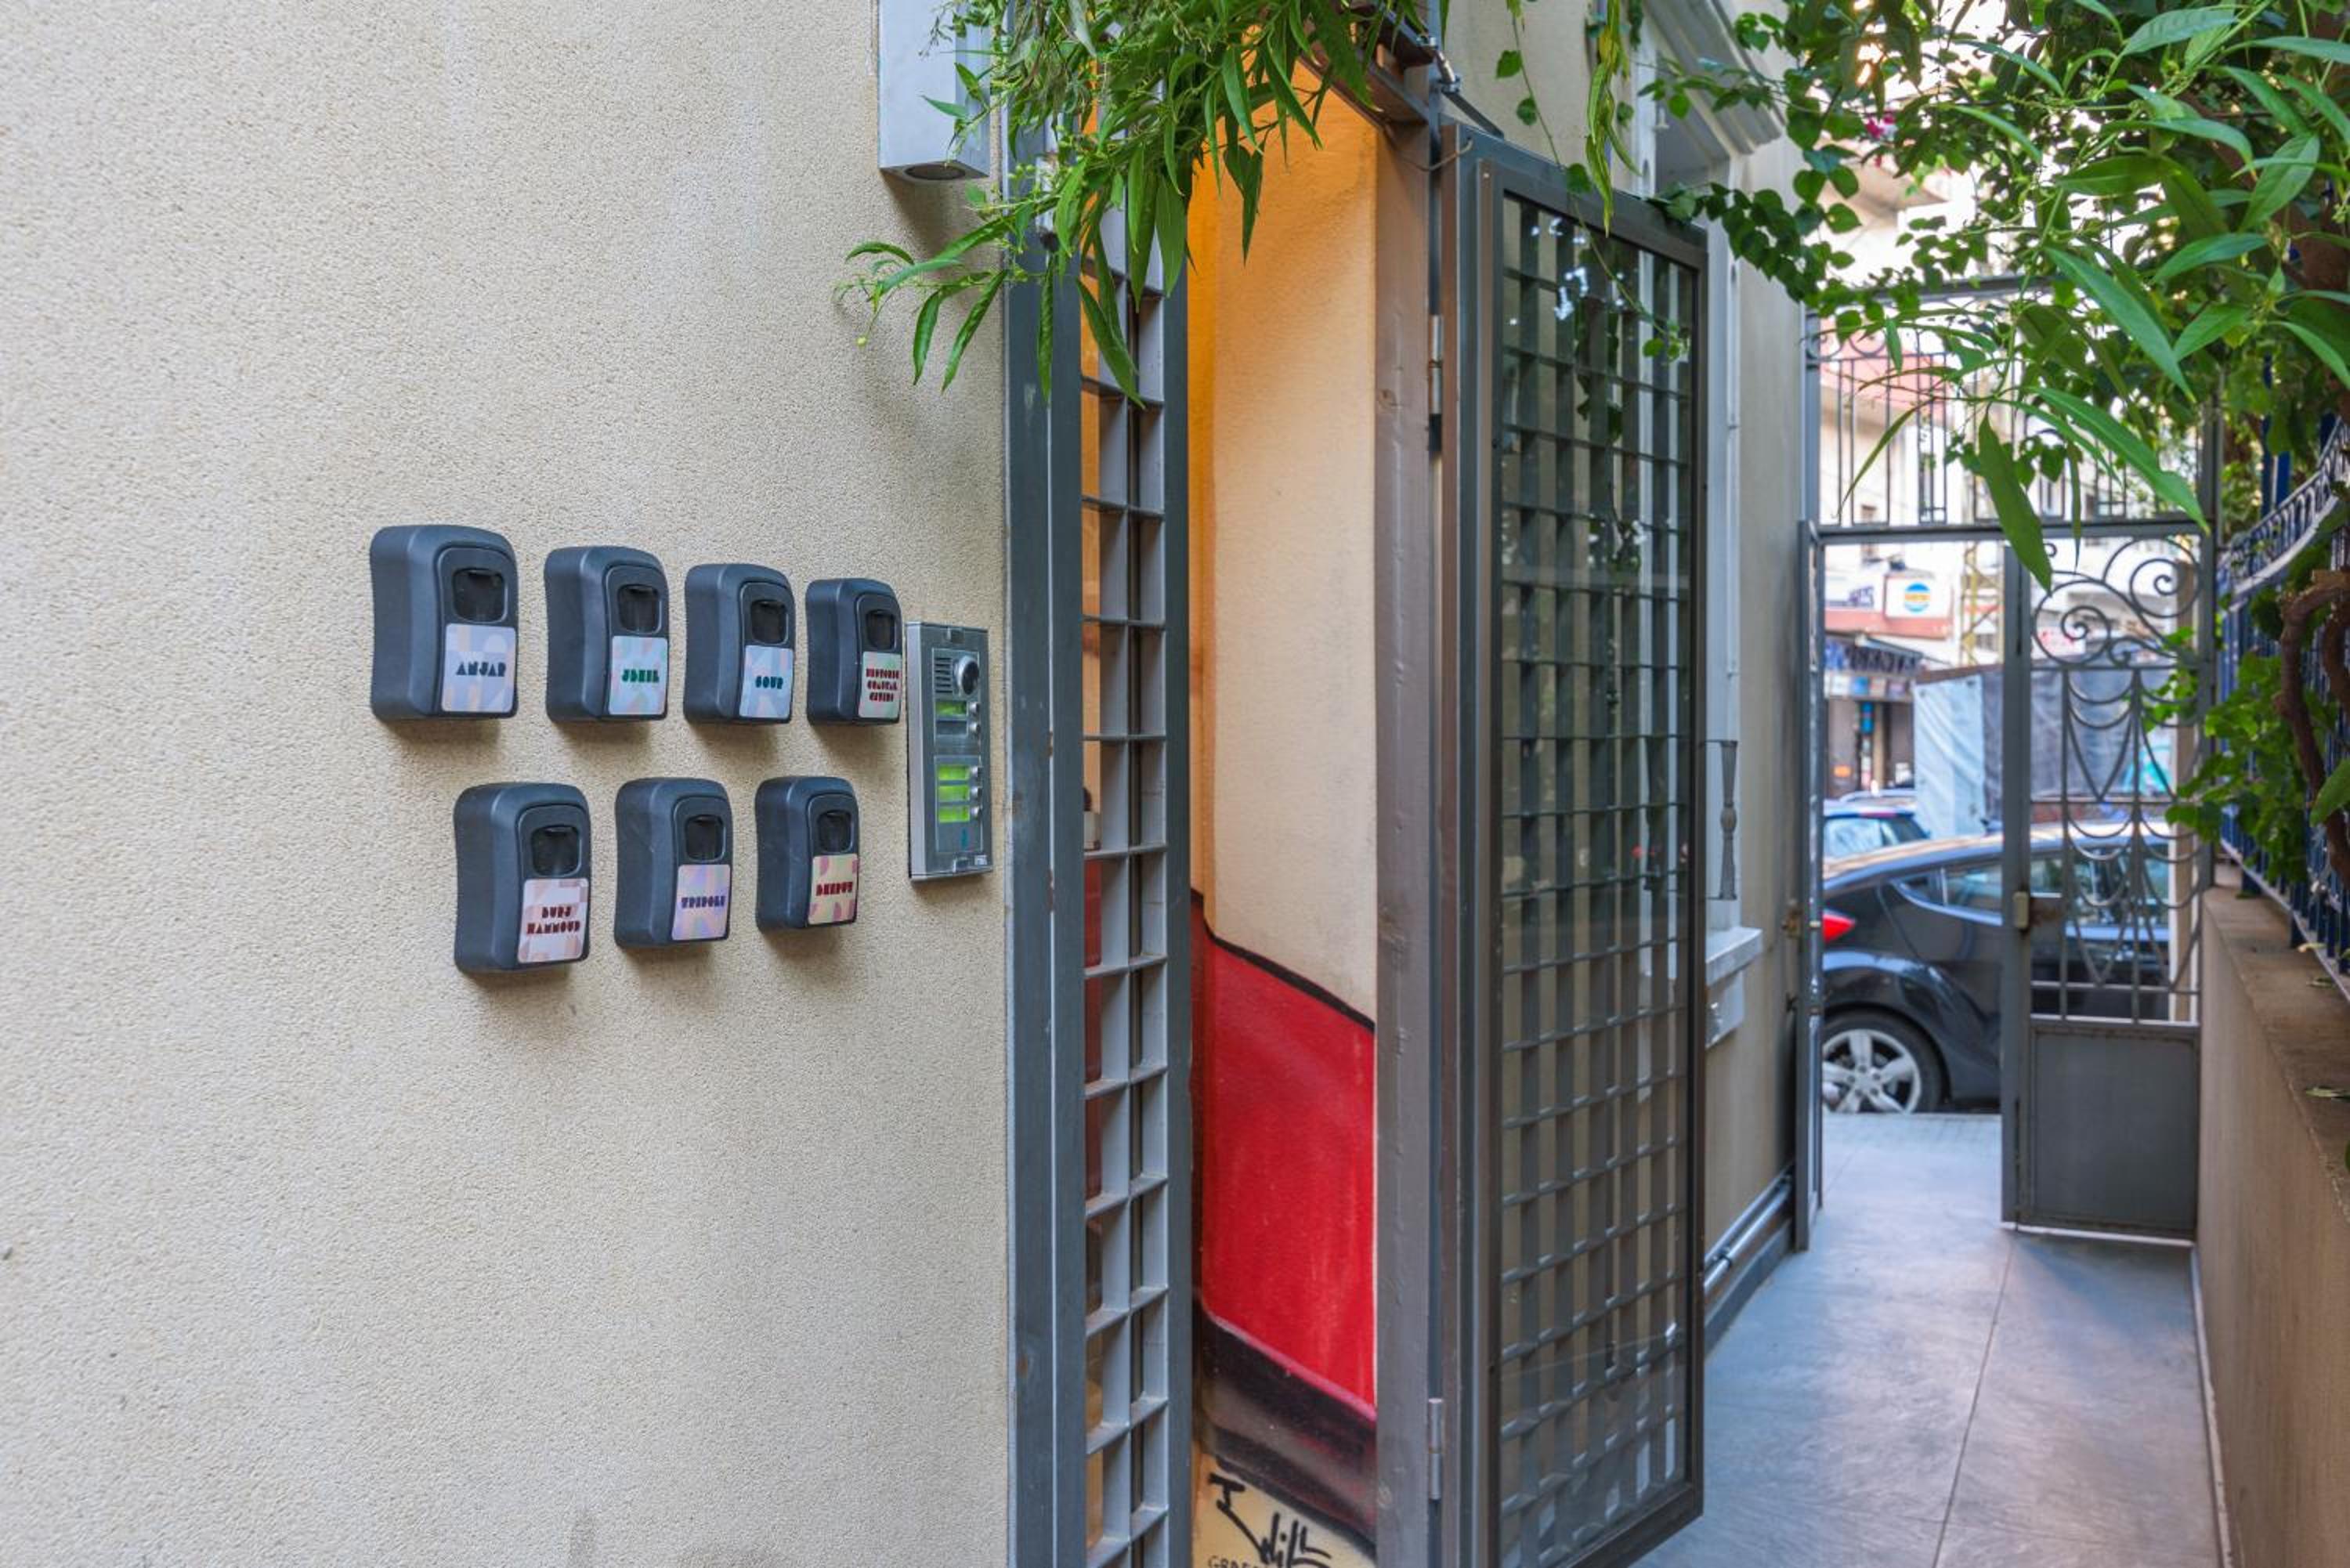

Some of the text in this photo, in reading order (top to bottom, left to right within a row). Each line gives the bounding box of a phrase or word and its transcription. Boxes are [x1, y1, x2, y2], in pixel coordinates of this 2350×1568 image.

[456, 661, 506, 677] ANJAR
[755, 675, 783, 689] SOUR
[816, 881, 853, 896] BEIRUT
[681, 895, 725, 909] TRIPOLI
[542, 906, 571, 918] BURJ
[527, 920, 580, 934] HAMMOUD
